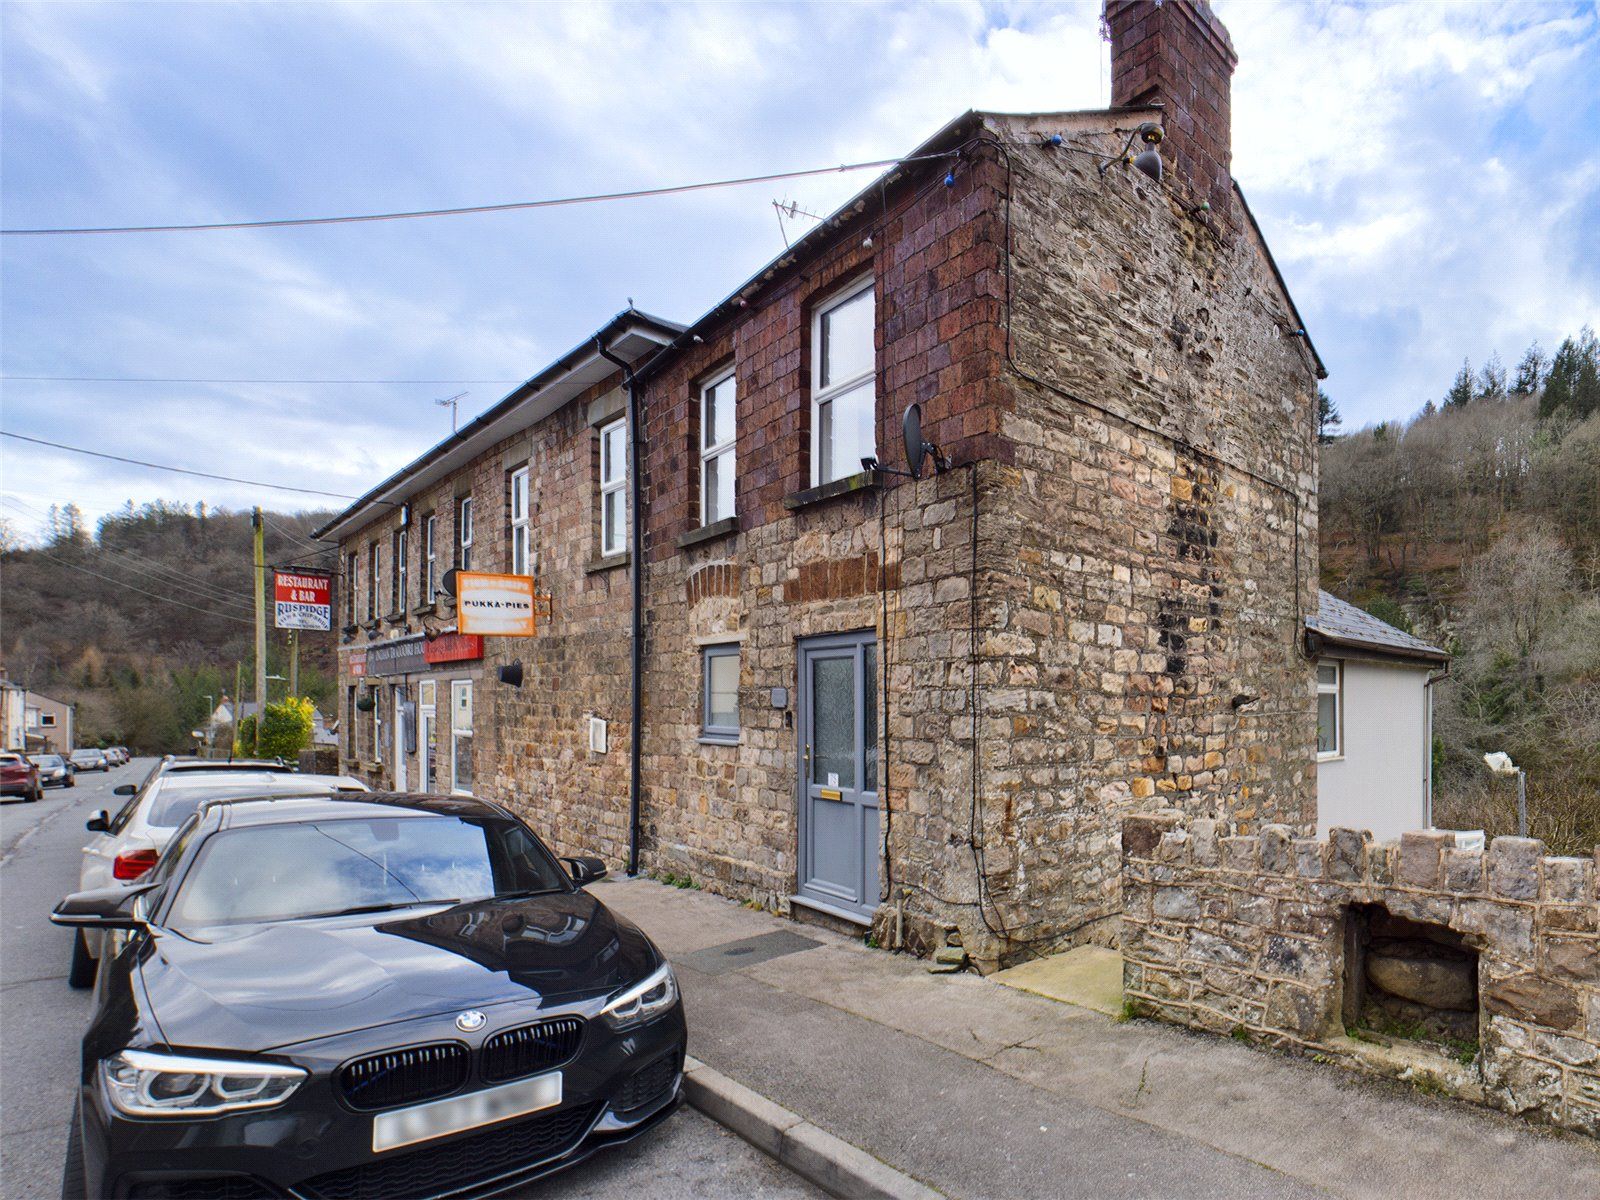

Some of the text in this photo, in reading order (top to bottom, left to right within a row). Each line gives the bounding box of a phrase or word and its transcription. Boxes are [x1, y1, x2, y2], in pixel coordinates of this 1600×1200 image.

[277, 574, 328, 590] RESTAURANT
[290, 589, 316, 602] & BAR
[277, 603, 329, 619] RUSPIDGE
[464, 600, 530, 609] PUKKA-PIES
